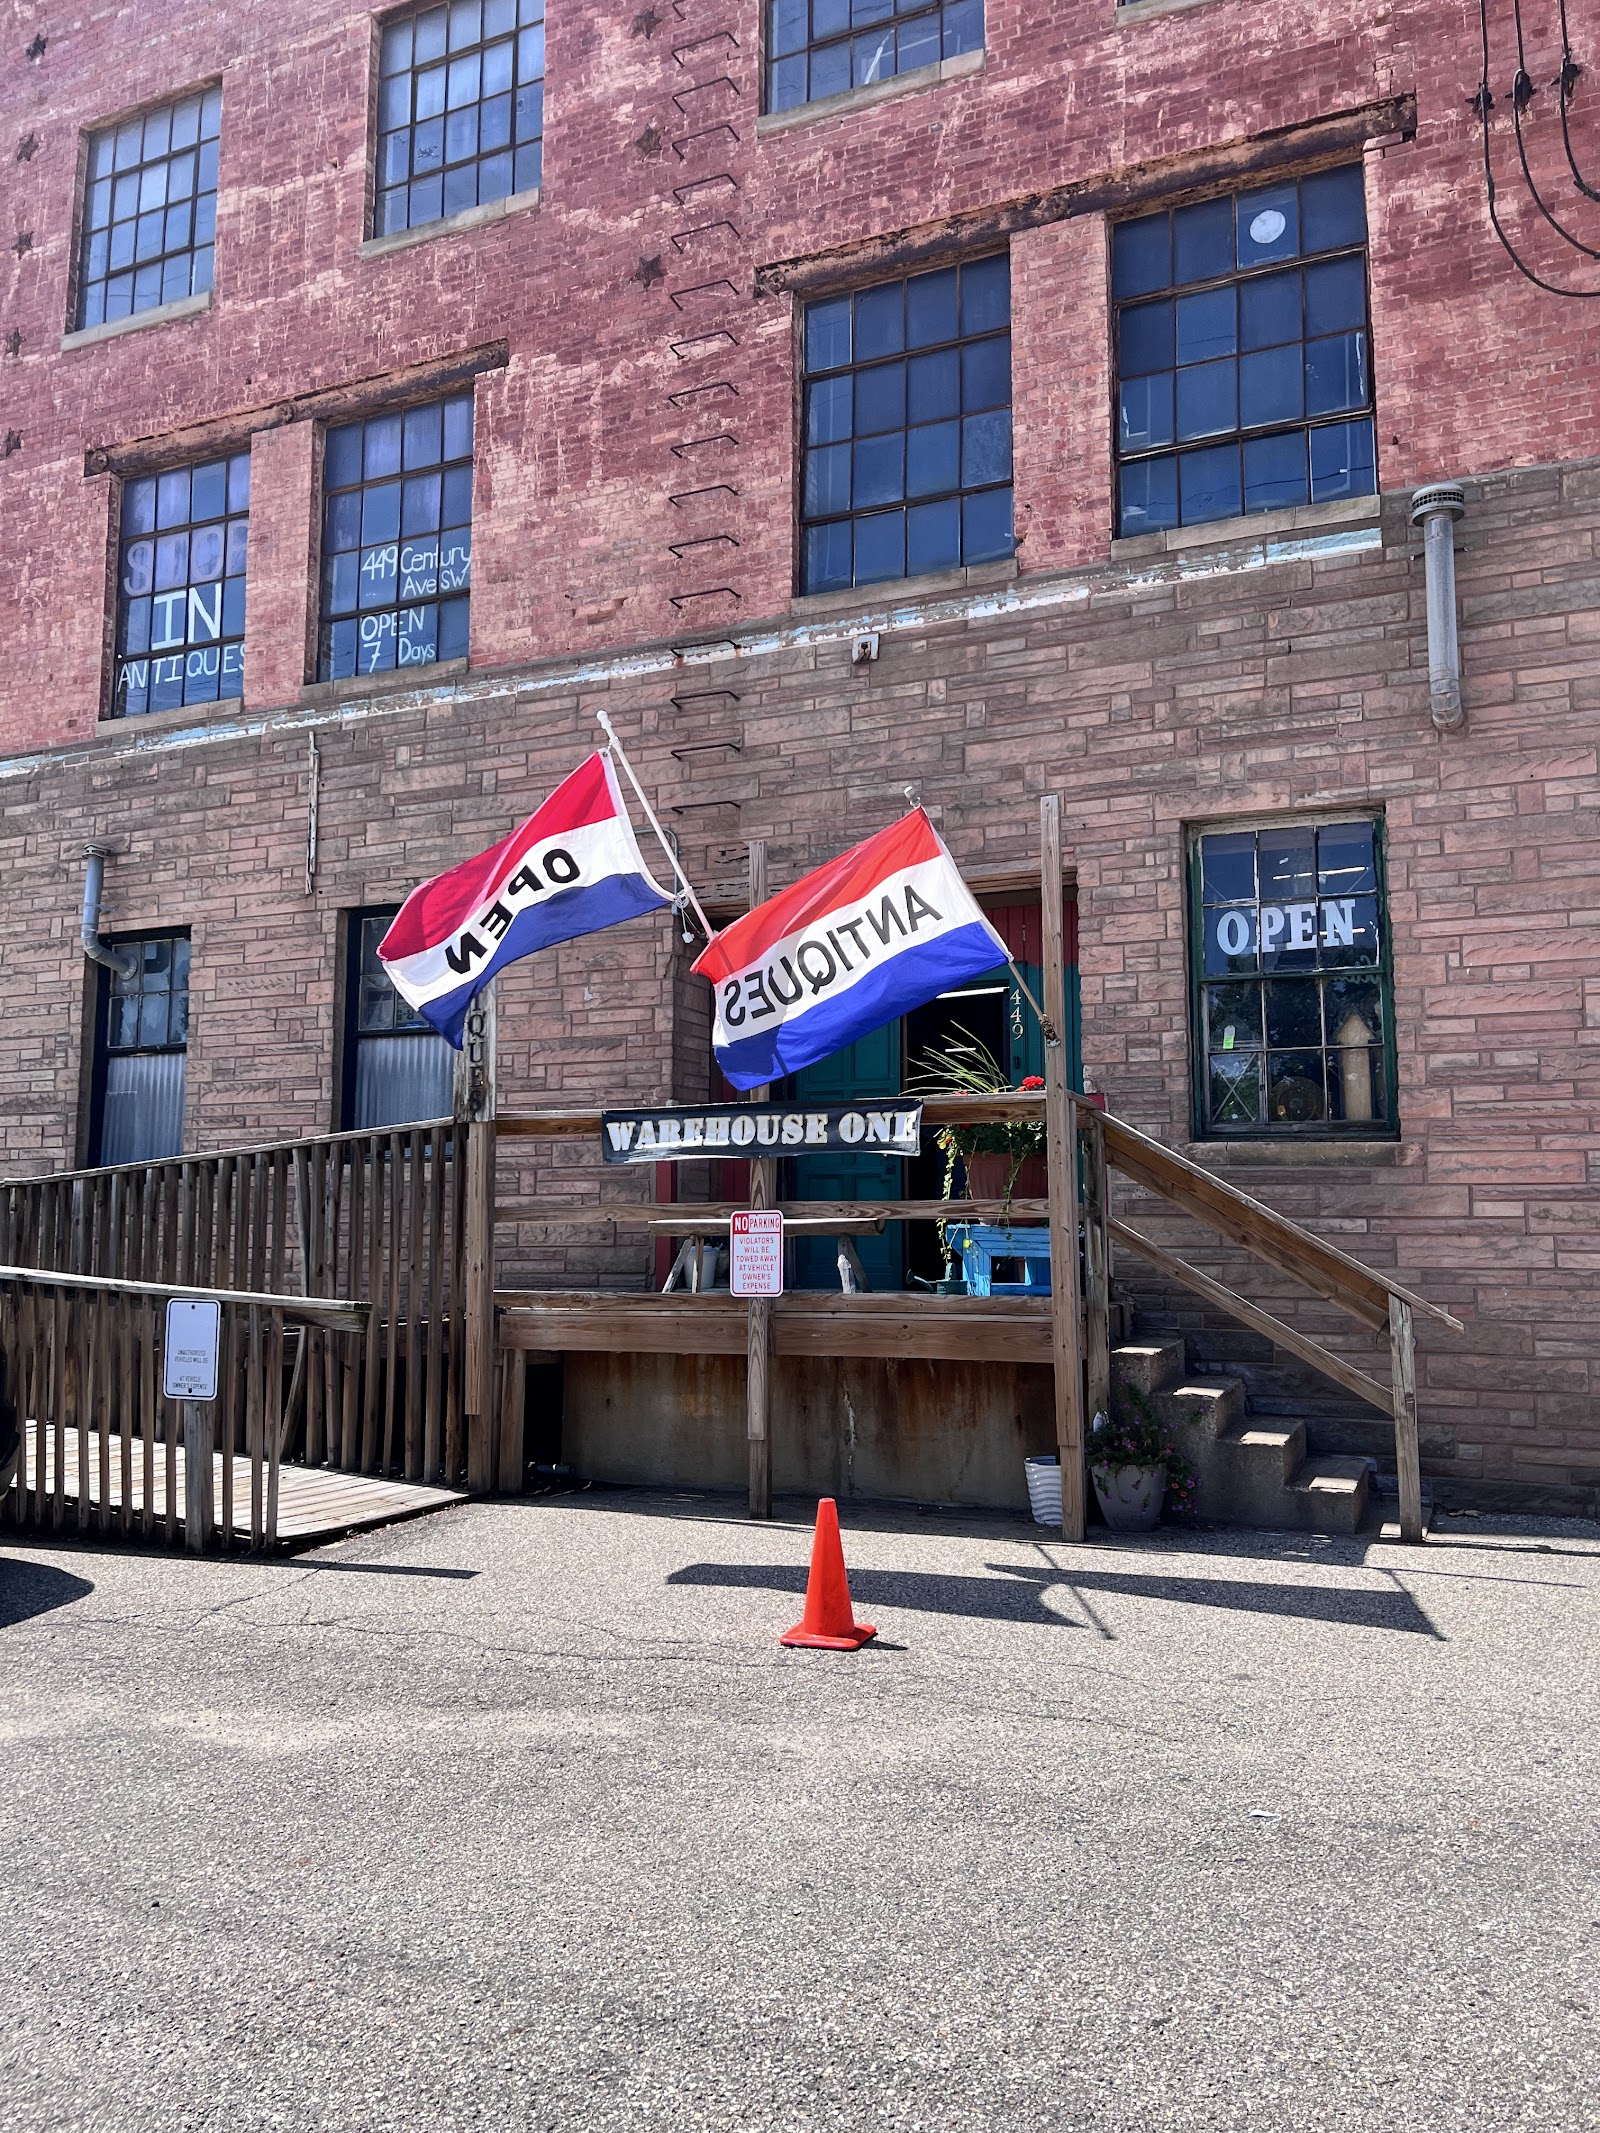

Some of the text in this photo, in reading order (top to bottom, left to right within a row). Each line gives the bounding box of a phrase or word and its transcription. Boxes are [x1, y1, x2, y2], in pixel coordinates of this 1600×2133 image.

[361, 543, 471, 580] 449 Century
[403, 569, 466, 597] Ave SW
[151, 583, 221, 651] IN
[361, 606, 424, 641] OPEN
[363, 638, 436, 673] 7 Days
[1216, 898, 1356, 956] OPEN
[1010, 988, 1024, 1040] 449
[606, 1110, 918, 1152] WAREHOUSE ONE
[734, 1216, 780, 1231] NO PARKING
